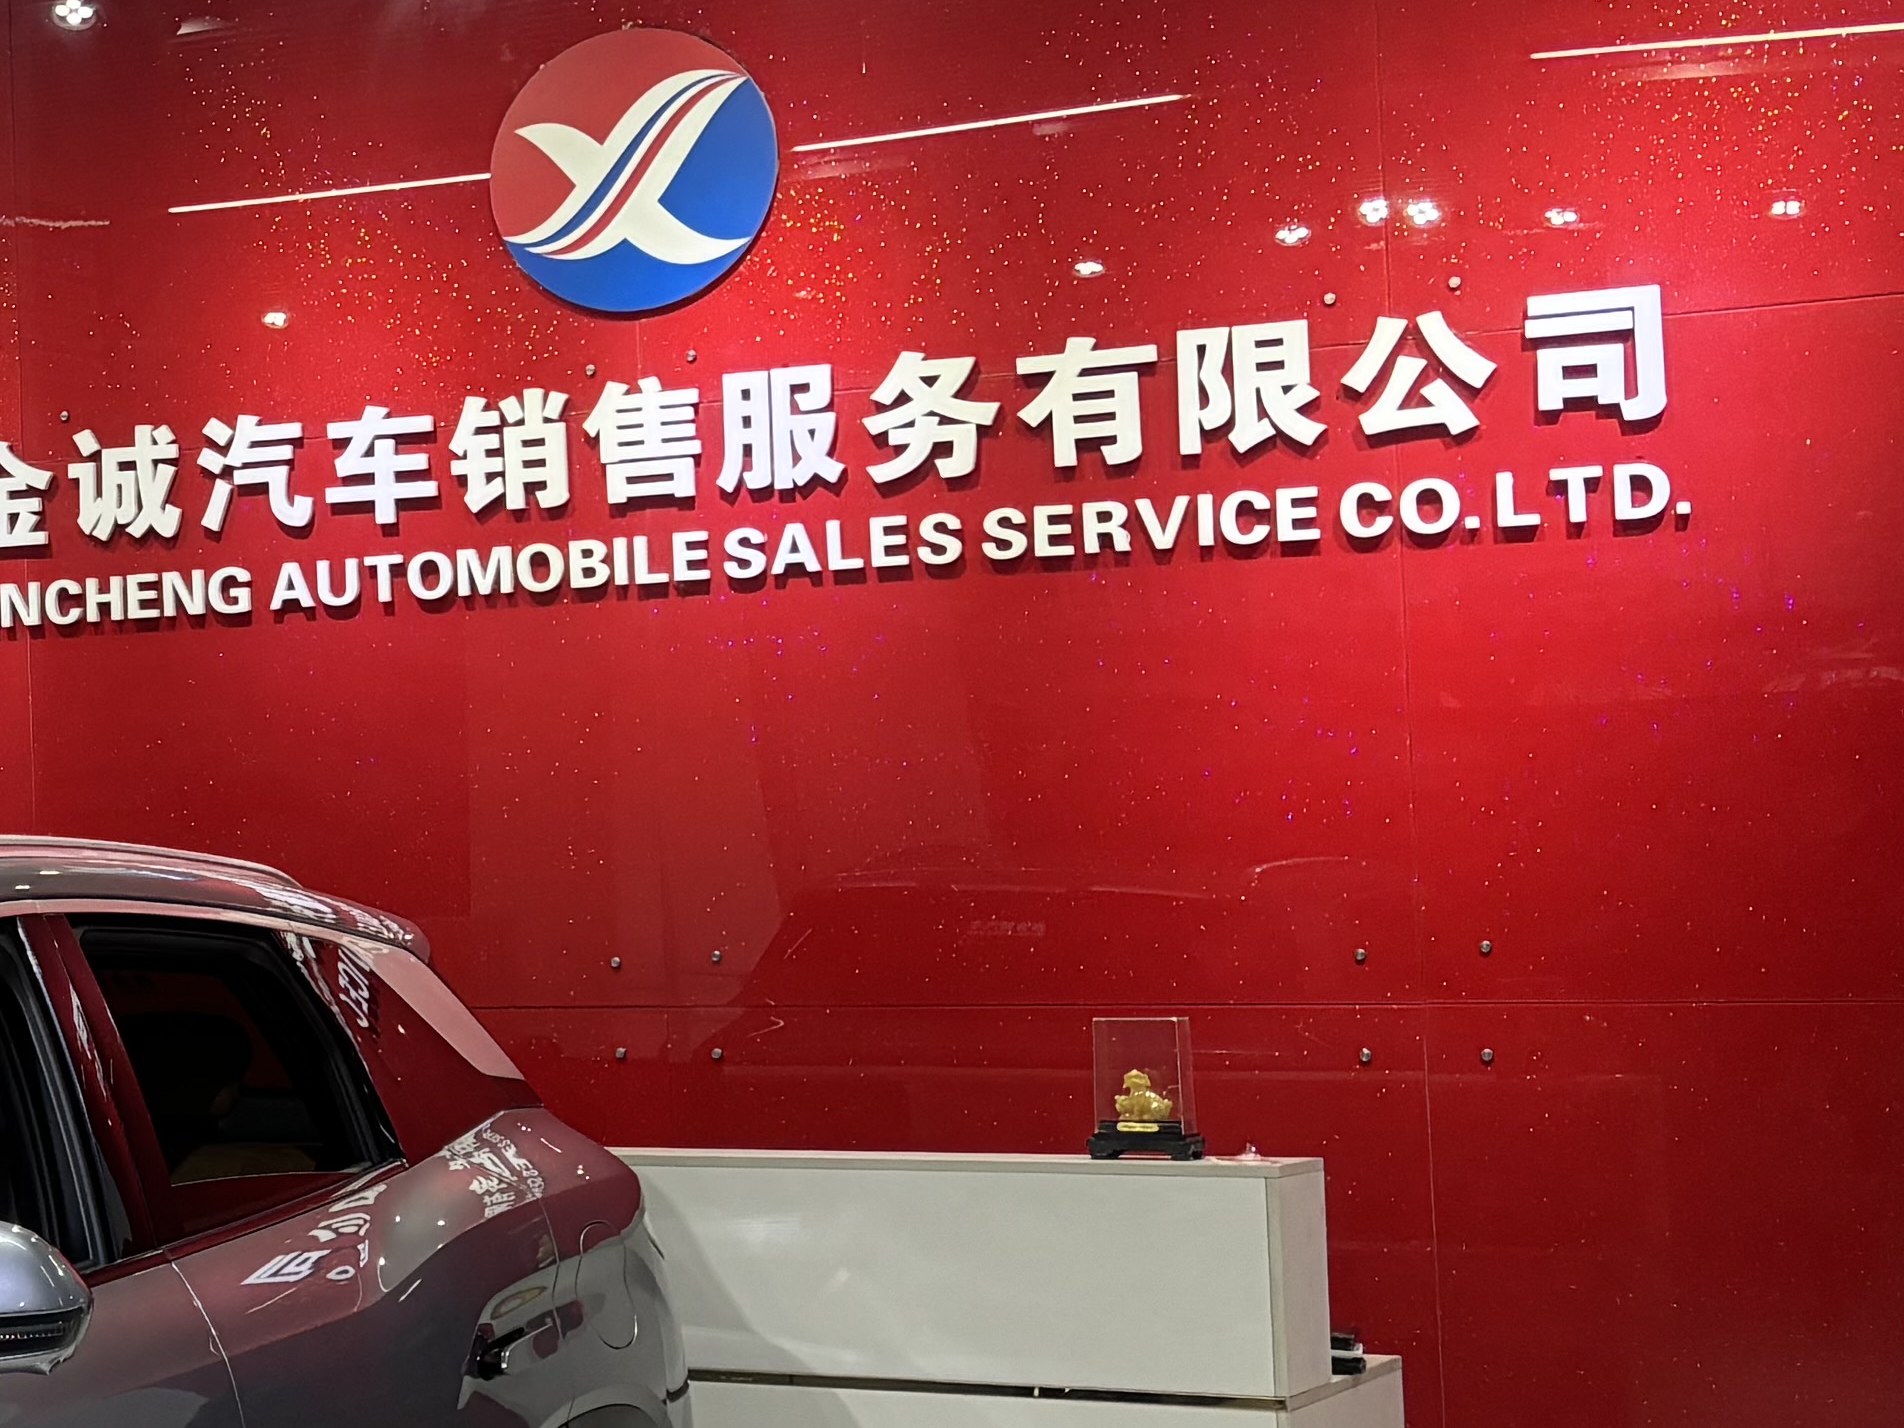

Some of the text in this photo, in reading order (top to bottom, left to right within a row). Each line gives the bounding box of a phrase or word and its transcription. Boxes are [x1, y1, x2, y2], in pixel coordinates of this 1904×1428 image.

[269, 529, 711, 610] AUTOMOBILE
[722, 512, 964, 580] SALES
[980, 486, 1321, 560] SERVICE
